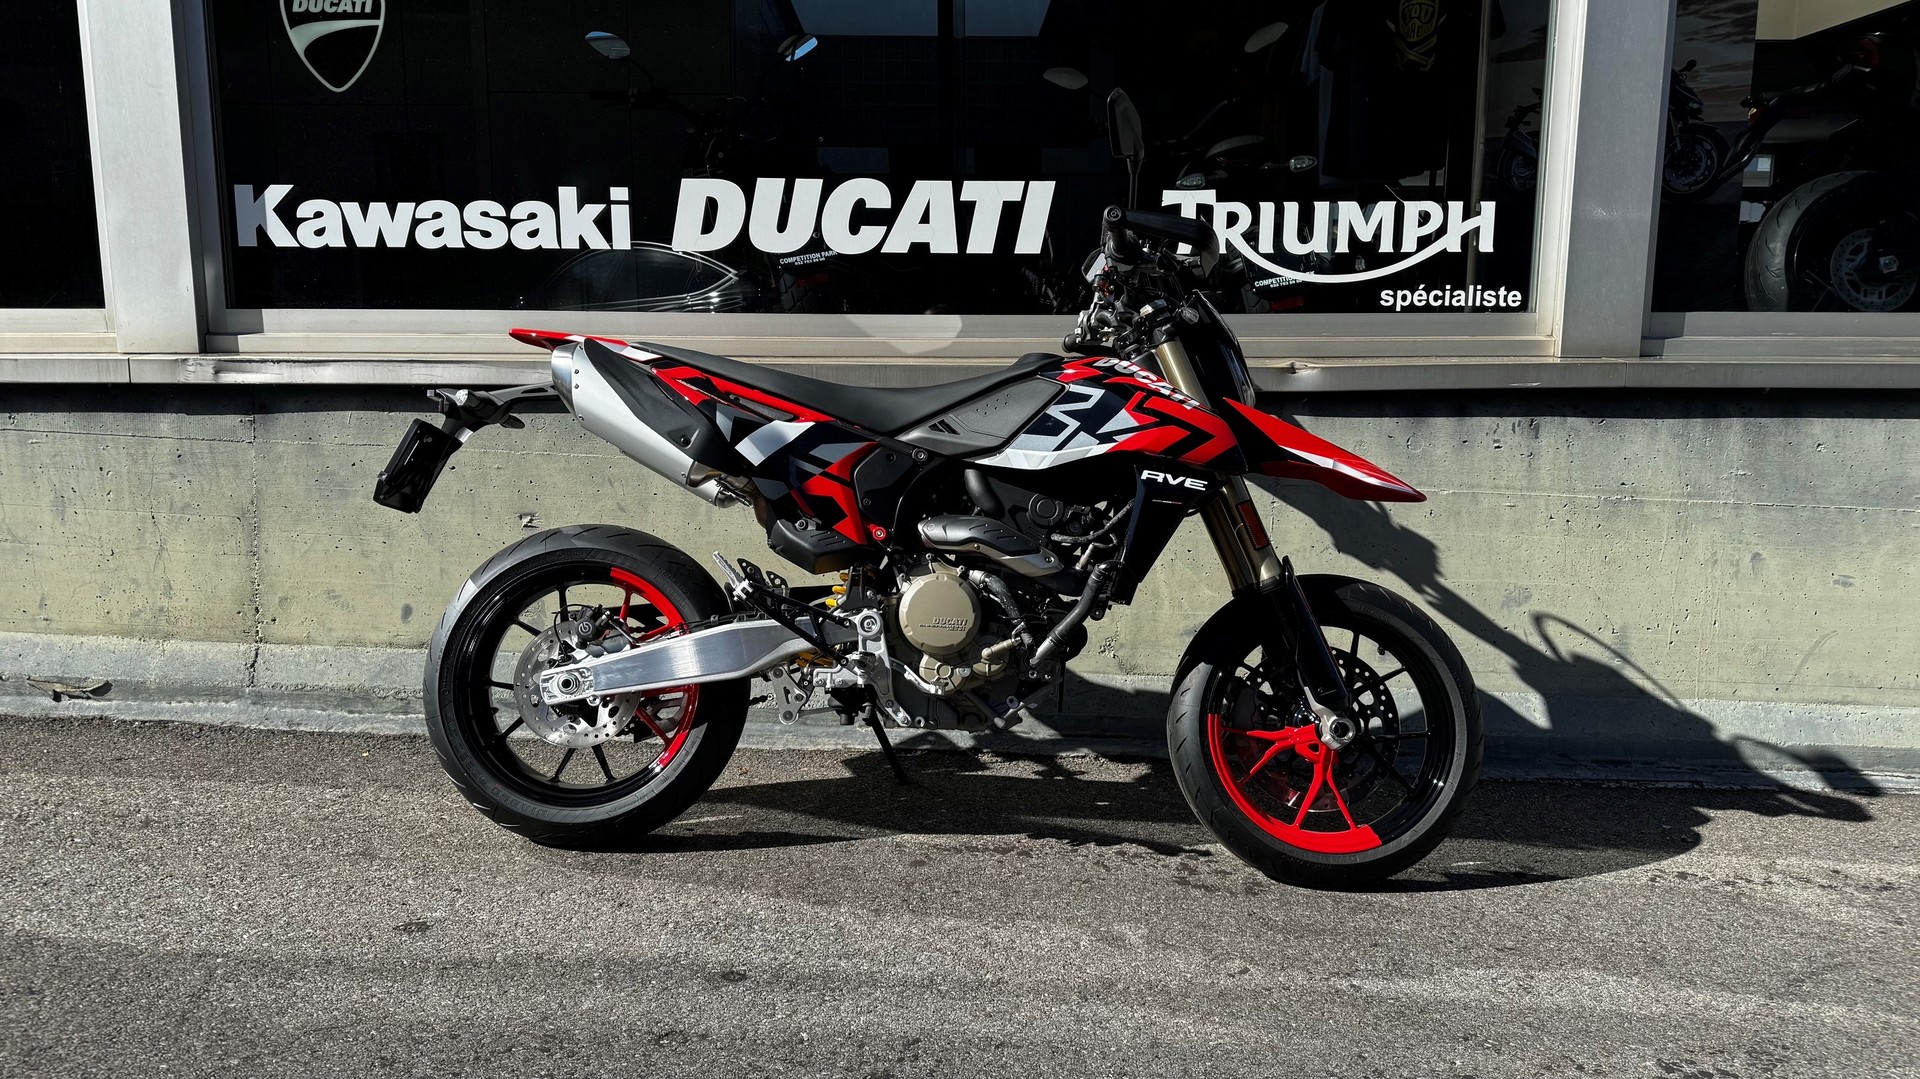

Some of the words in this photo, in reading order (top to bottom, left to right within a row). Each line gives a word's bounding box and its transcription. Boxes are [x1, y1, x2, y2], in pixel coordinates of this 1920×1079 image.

[292, 0, 373, 13] DUCATI
[234, 184, 631, 249] Kawasaki
[672, 177, 1056, 255] DUCATI
[1162, 189, 1497, 283] TRIUMPH
[780, 253, 821, 264] COMPETITION
[1254, 276, 1294, 287] COMPETITIO
[1380, 284, 1522, 312] spécialiste
[1092, 357, 1200, 410] DUCATI
[932, 616, 968, 627] DUCATI
